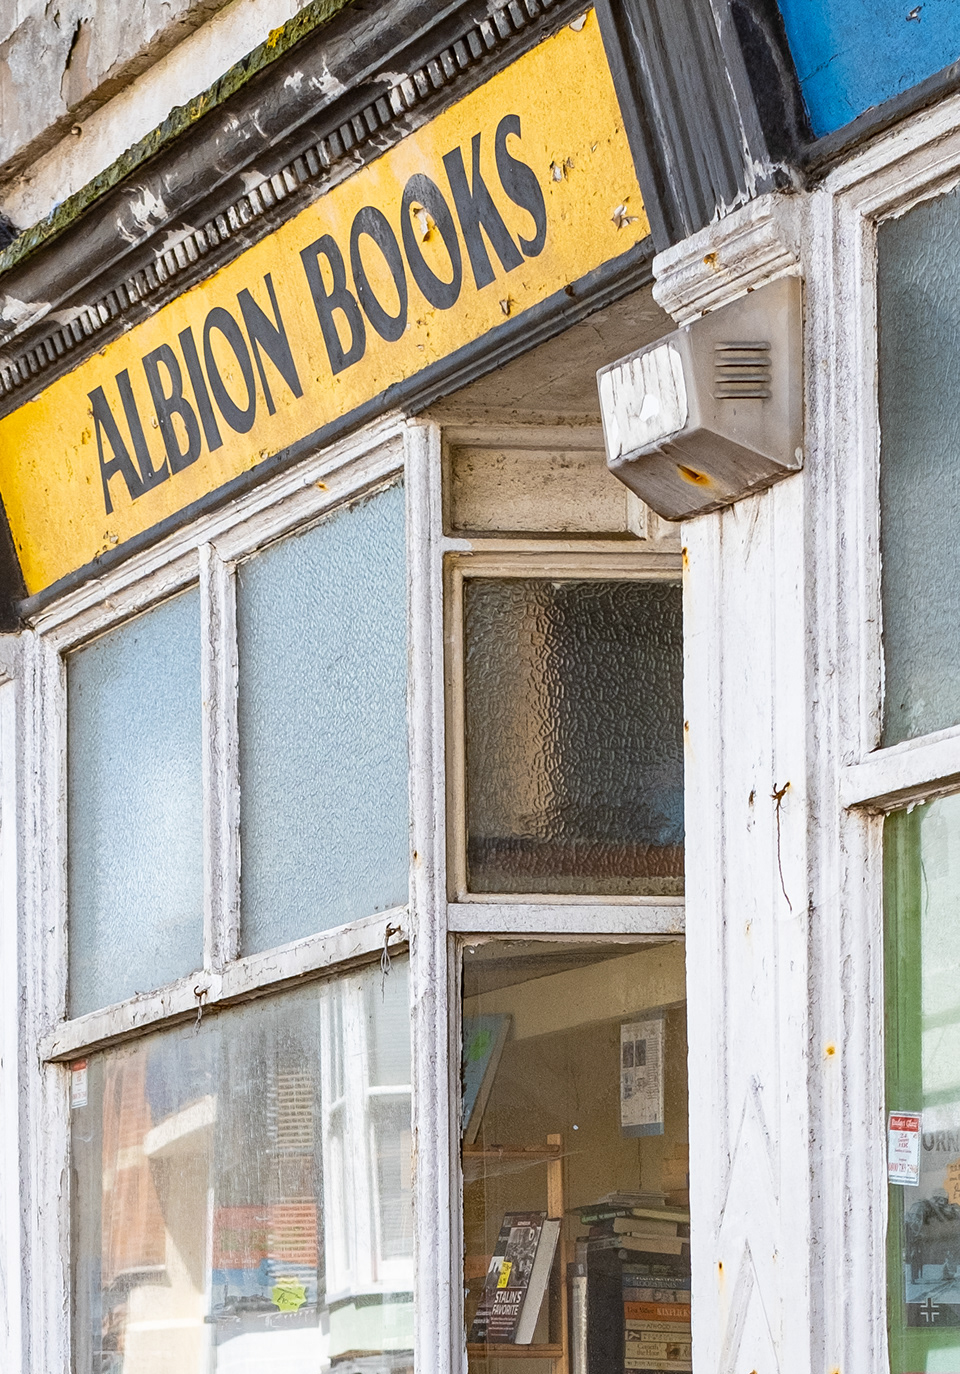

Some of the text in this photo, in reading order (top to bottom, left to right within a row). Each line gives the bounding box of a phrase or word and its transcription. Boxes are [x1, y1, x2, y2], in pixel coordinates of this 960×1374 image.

[87, 113, 548, 515] ALBION BOOKS
[491, 1304, 520, 1316] FAVORITE
